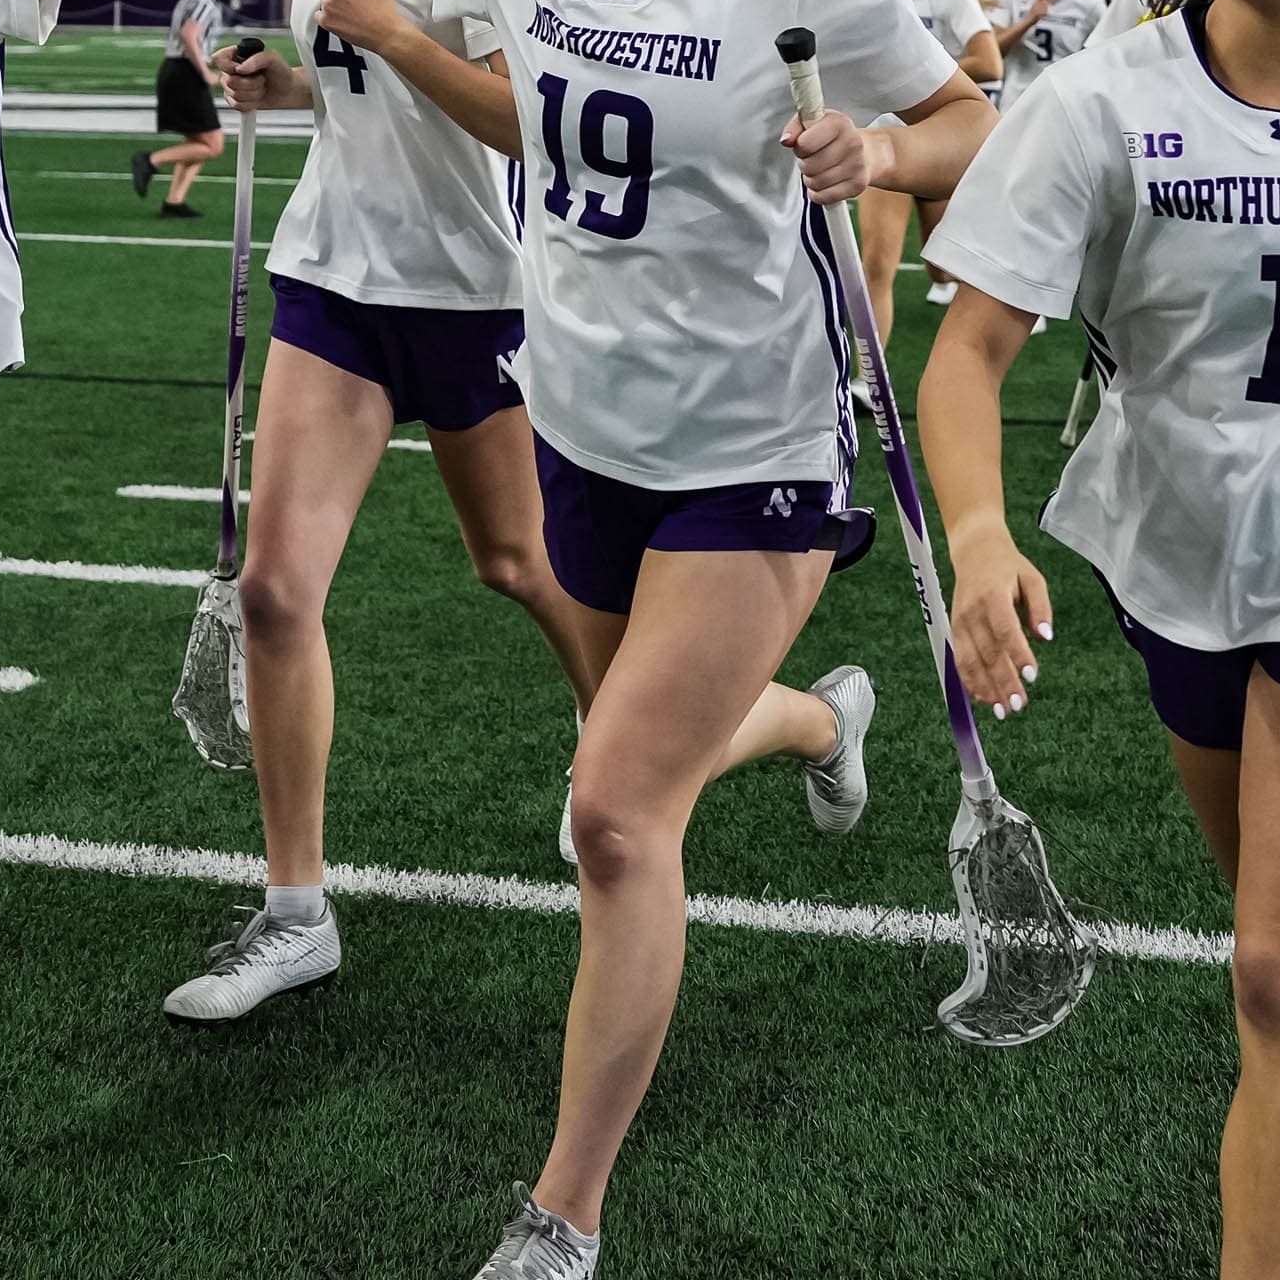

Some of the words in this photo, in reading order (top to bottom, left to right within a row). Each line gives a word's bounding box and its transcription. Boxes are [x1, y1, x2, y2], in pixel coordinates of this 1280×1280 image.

[313, 25, 368, 94] 4
[526, 1, 721, 81] NORTHWESTERN
[1035, 29, 1052, 61] 3
[537, 71, 653, 240] 19
[854, 337, 880, 396] SHOW
[872, 400, 895, 452] LAKE
